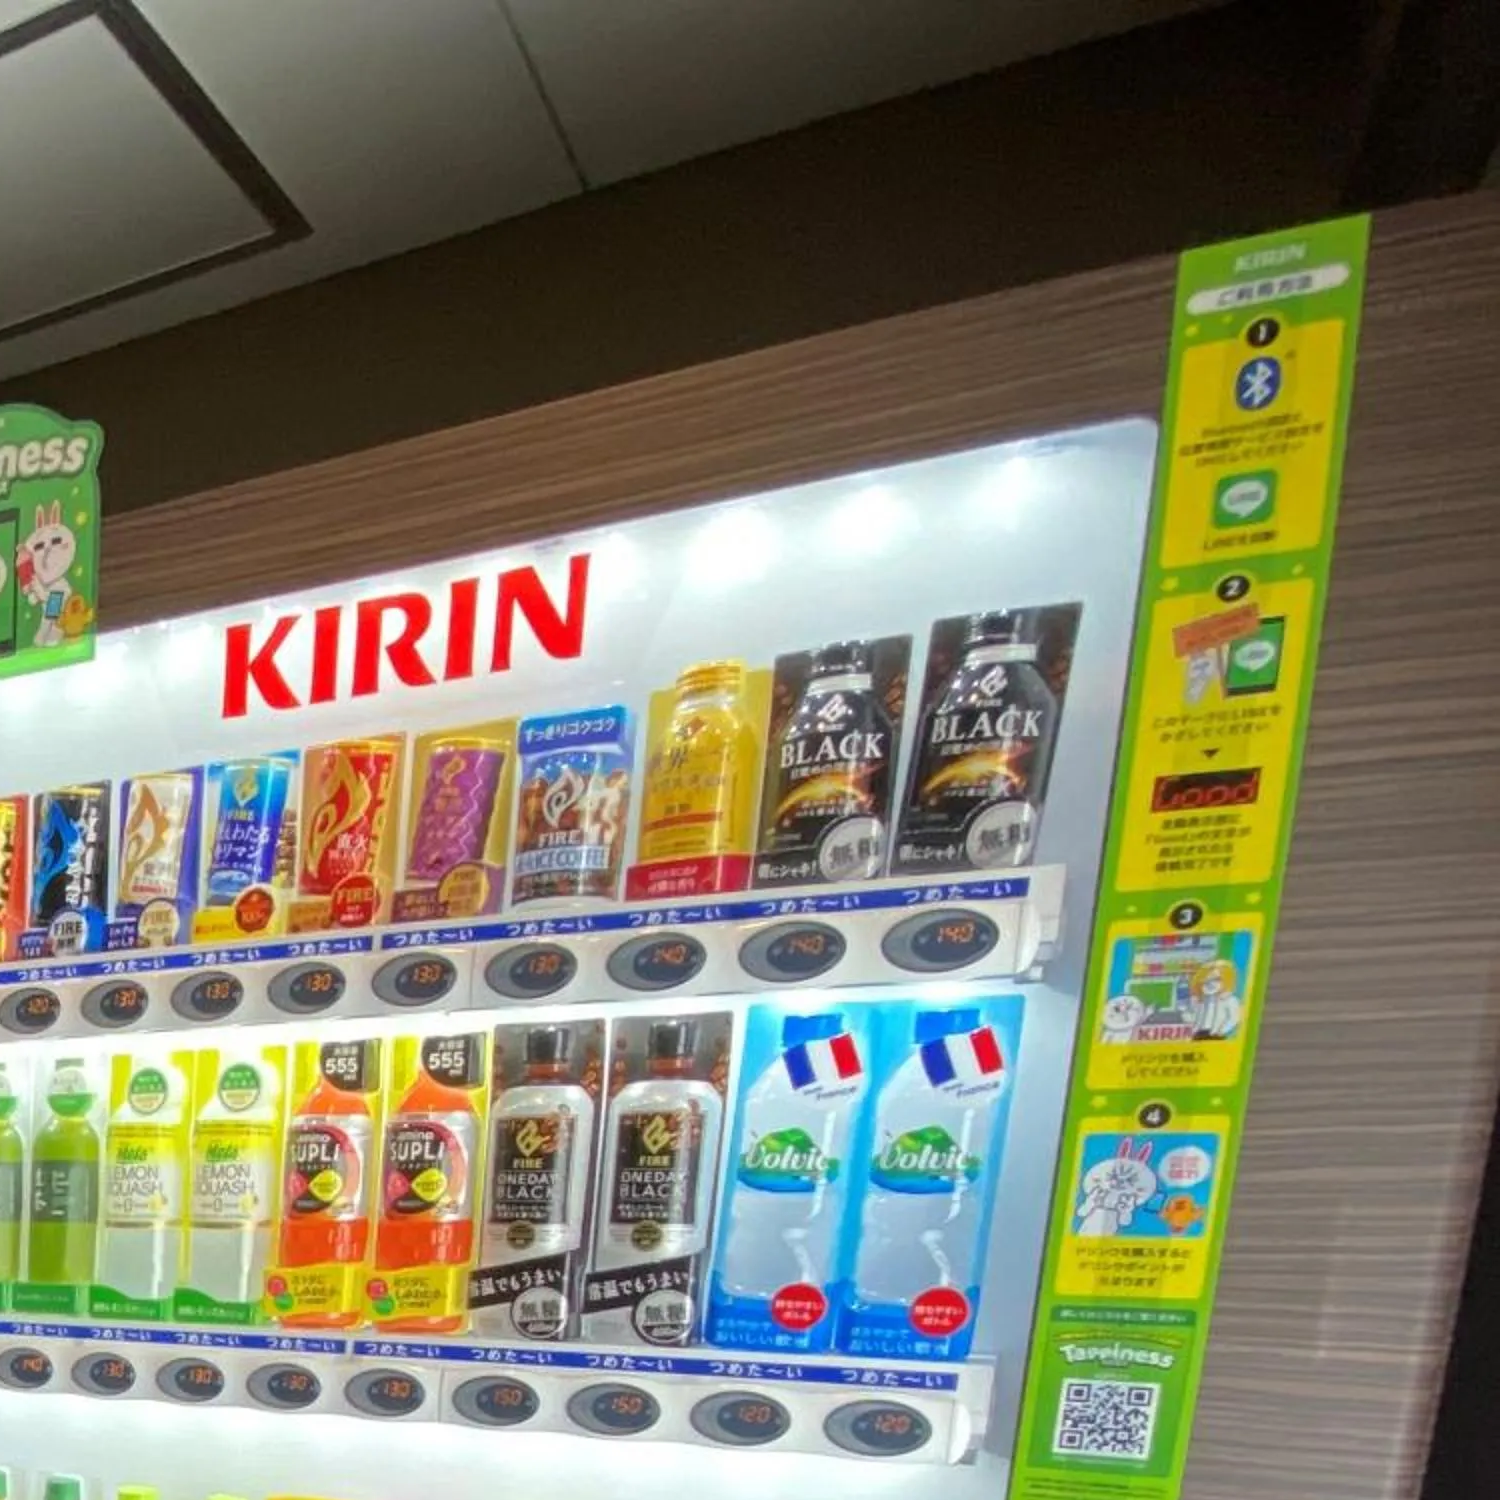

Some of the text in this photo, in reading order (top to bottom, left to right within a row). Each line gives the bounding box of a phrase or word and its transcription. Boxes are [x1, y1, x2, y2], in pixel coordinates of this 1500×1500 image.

[1226, 580, 1241, 597] 2
[222, 553, 592, 719] KIRIN
[932, 705, 1043, 744] BLACK
[781, 731, 884, 769] BLACK
[539, 829, 583, 848] FIRE
[53, 921, 82, 936] FIRE
[936, 922, 976, 944] 140
[325, 1056, 359, 1075] 555
[428, 1051, 465, 1070] 555
[1147, 1107, 1162, 1125] 4
[391, 1142, 445, 1162] SUPLI
[744, 1131, 829, 1171] Volvic
[880, 1130, 972, 1171] Volvic
[512, 1157, 545, 1170] FIRE
[637, 1154, 672, 1168] FIRE
[620, 1170, 689, 1184] ONEDAY
[1059, 1341, 1176, 1371] Tappiness
[610, 1394, 644, 1415] 150
[873, 1413, 911, 1435] 120
